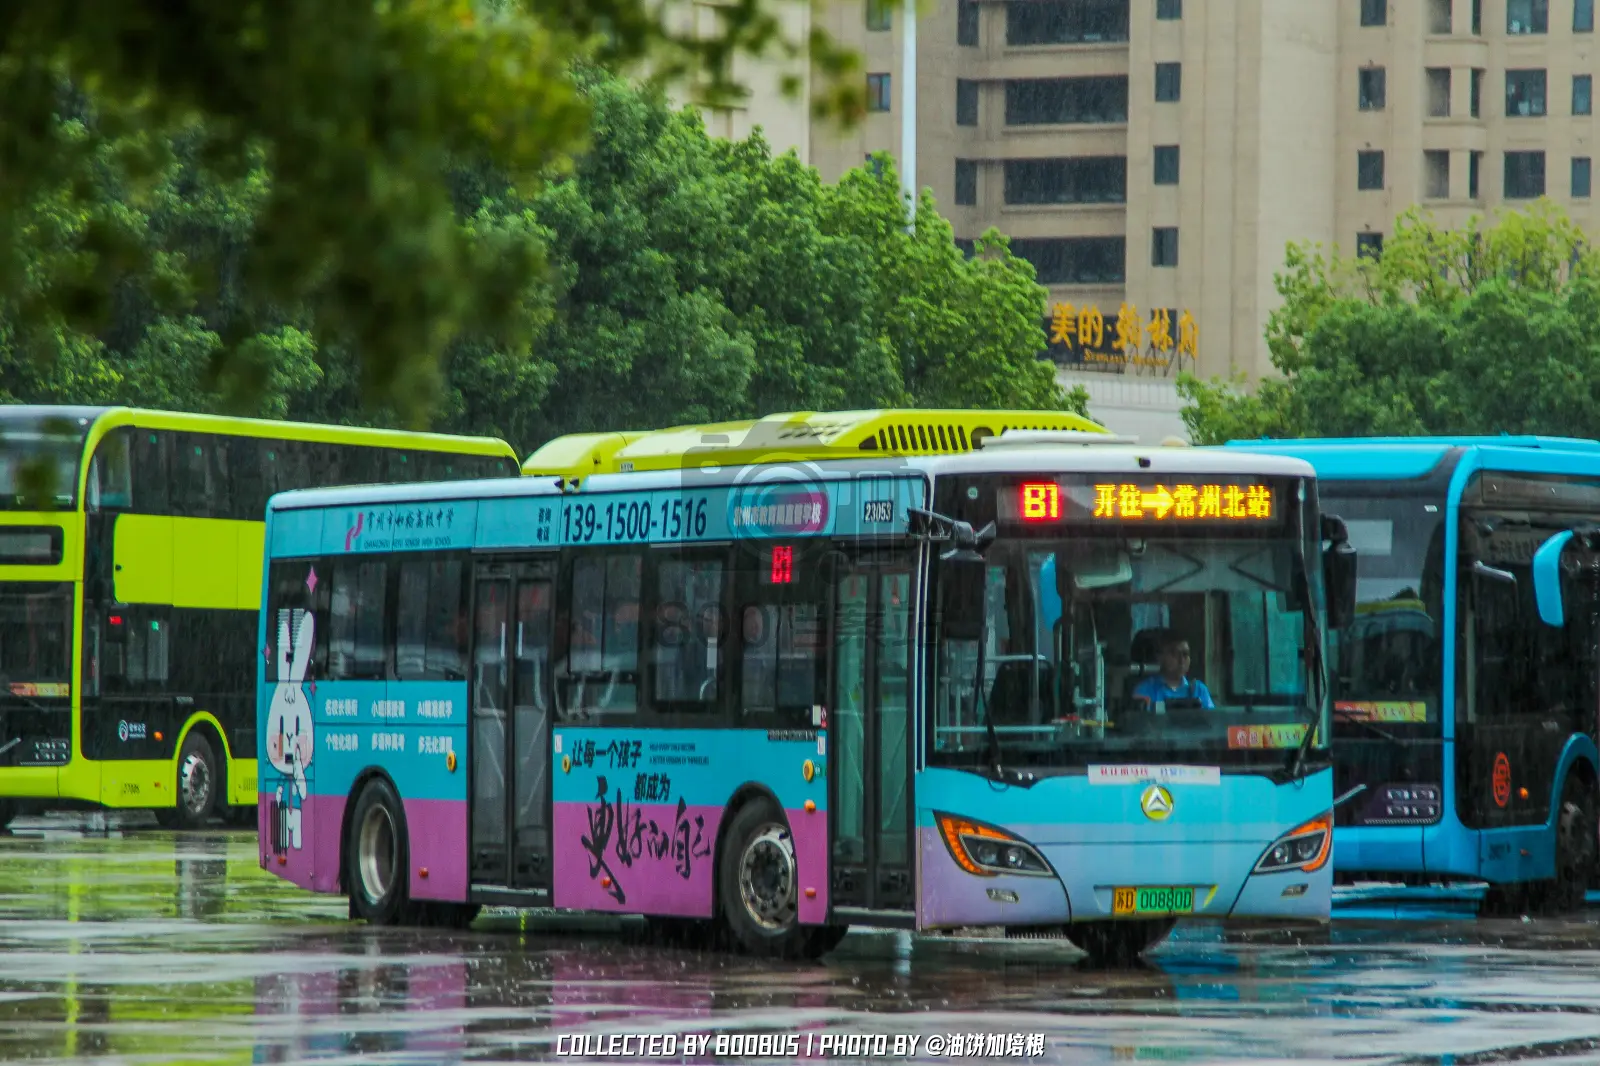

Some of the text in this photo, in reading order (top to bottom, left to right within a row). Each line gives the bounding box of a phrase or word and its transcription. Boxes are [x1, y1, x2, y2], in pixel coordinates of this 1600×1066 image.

[864, 501, 892, 522] 23053
[1022, 483, 1060, 518] B1
[1093, 484, 1271, 518] 开往 常州北站
[563, 497, 708, 543] 139-1500-1516
[572, 739, 642, 769] 让每一个孩子
[634, 772, 671, 801] 都成为
[581, 775, 711, 905] 更好的自己
